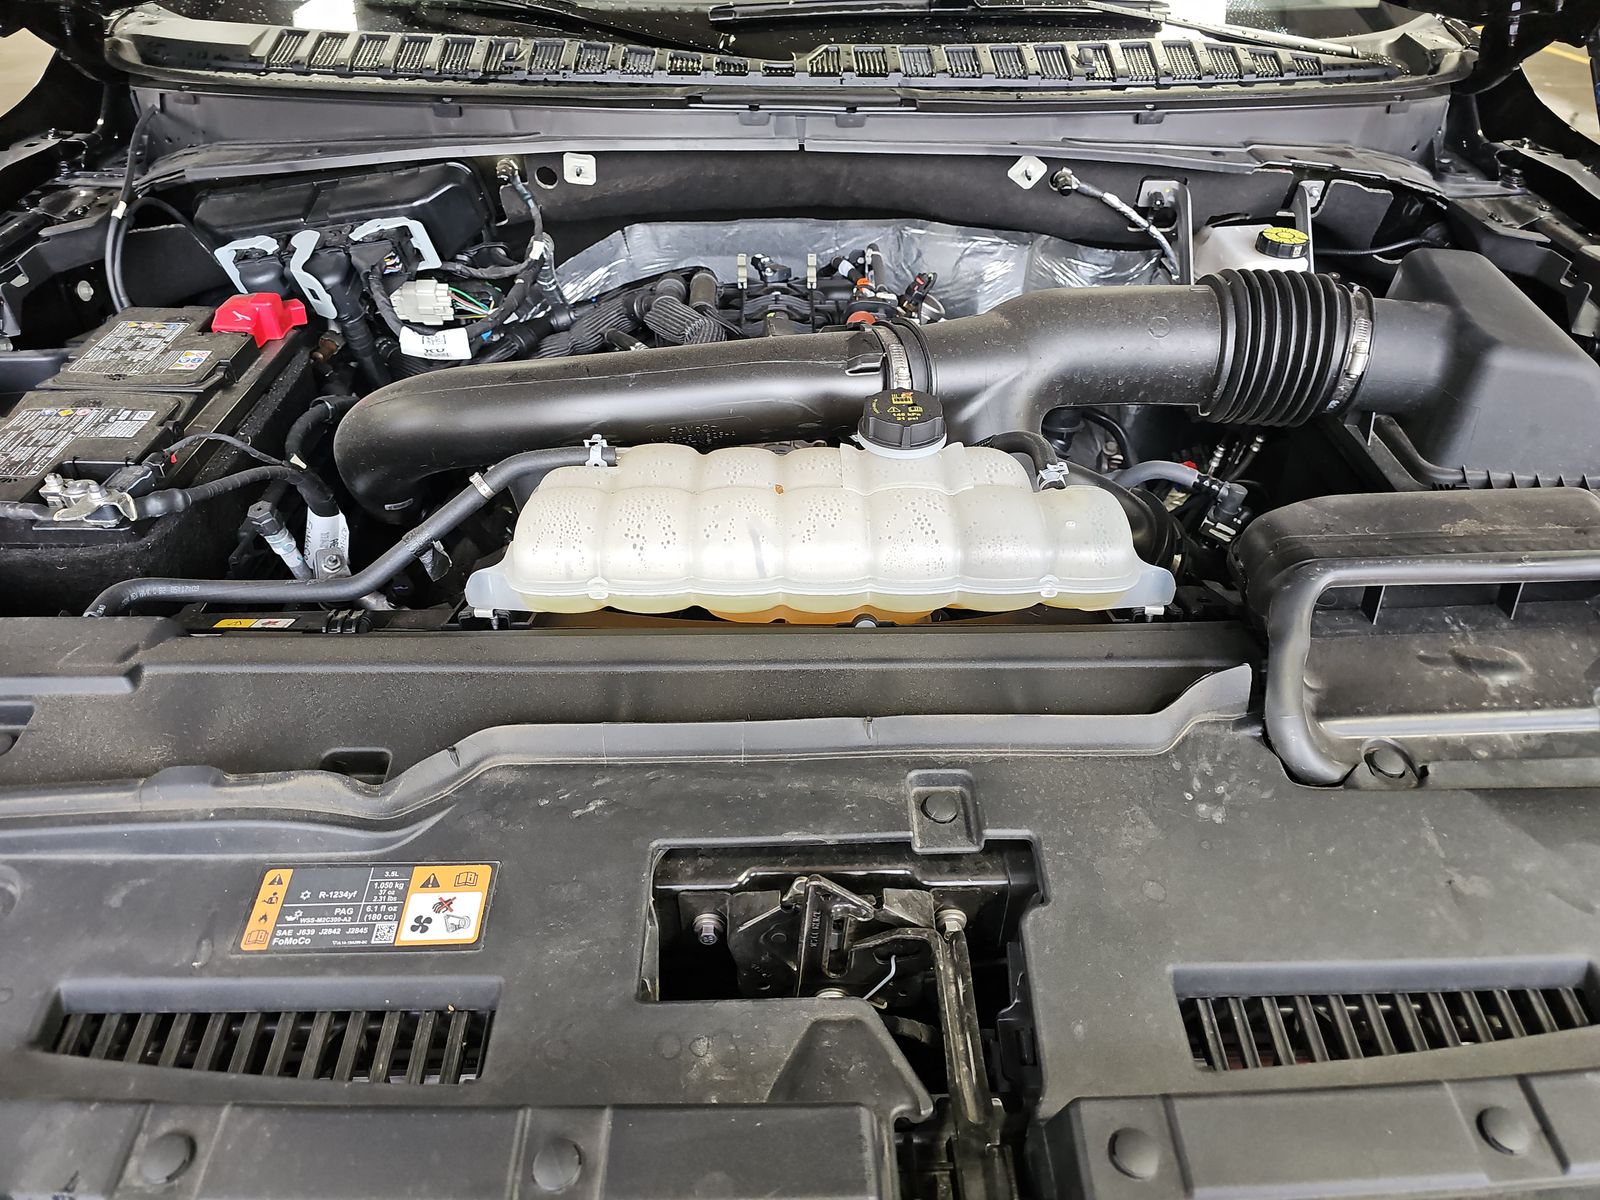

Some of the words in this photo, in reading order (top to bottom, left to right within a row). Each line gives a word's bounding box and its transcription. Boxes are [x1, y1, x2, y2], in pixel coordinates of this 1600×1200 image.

[394, 882, 405, 890] kg
[318, 890, 358, 899] R-1234yf
[364, 913, 382, 921] (180
[272, 937, 311, 946] FoMoCo
